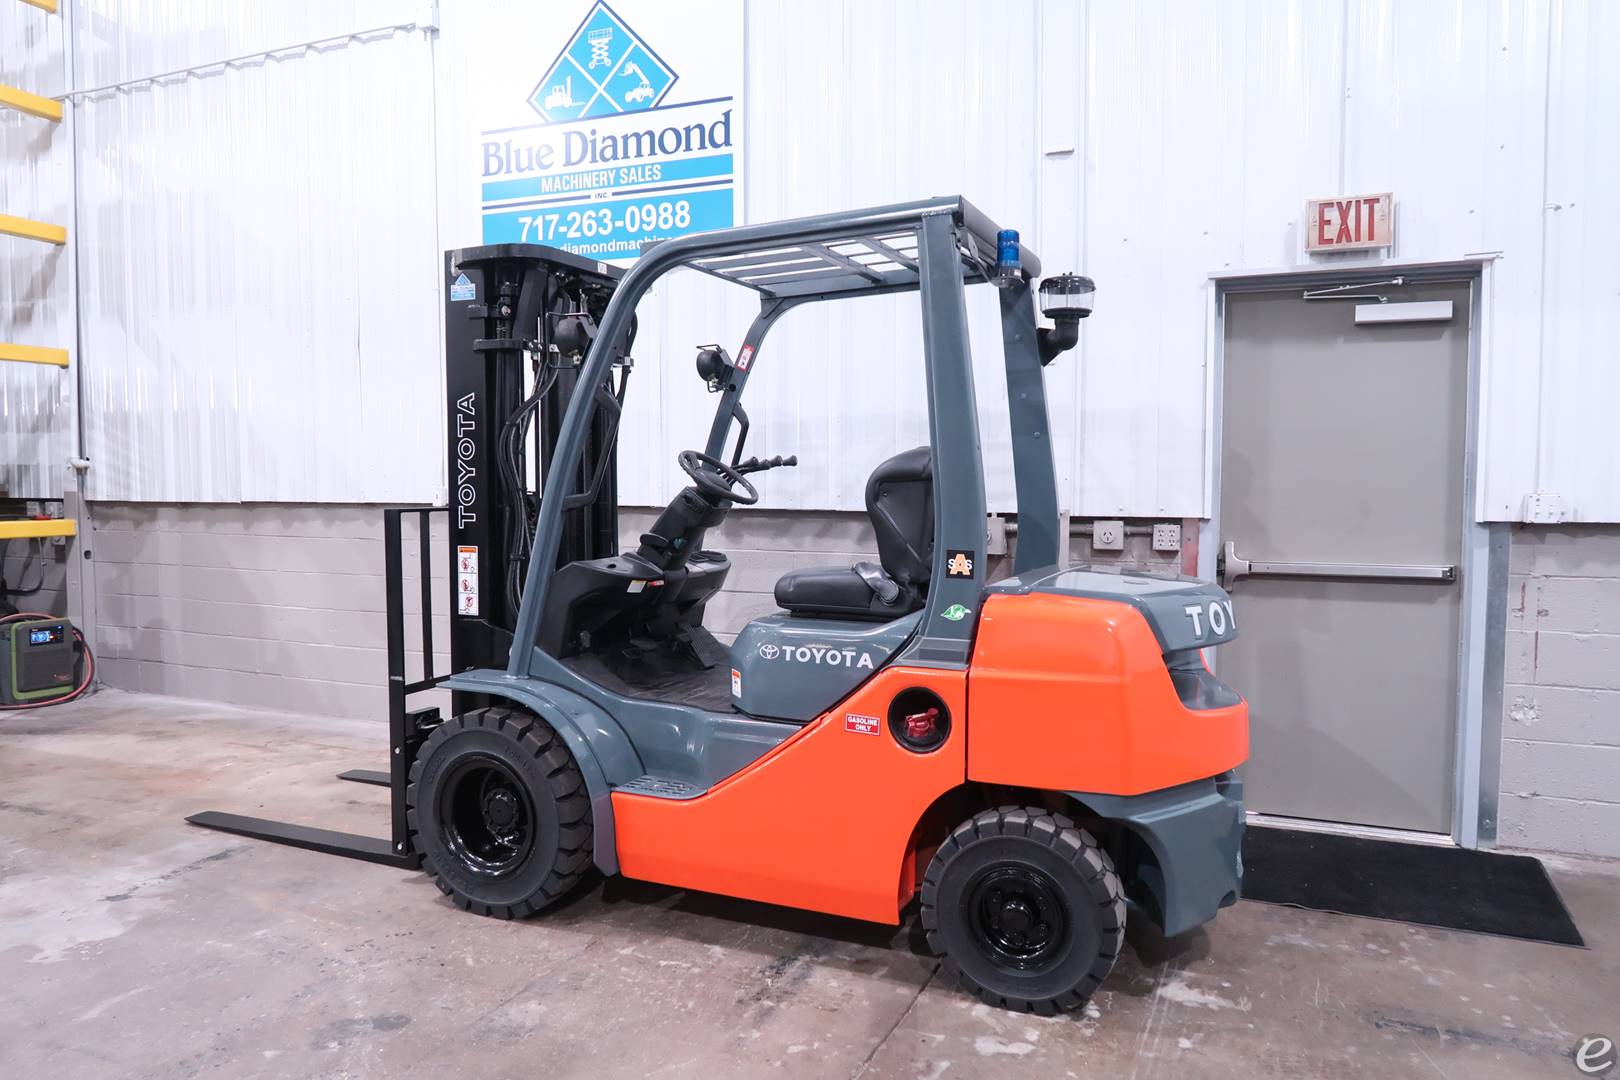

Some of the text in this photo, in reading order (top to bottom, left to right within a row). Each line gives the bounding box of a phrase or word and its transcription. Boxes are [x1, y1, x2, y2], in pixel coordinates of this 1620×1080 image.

[481, 109, 733, 177] Blue Diamond
[541, 164, 662, 193] MACHINERY SALES
[518, 200, 691, 243] 717-263-0988
[1318, 198, 1380, 245] EXIT
[457, 391, 476, 530] TOYOTA
[782, 645, 874, 669] TOYOTA
[847, 716, 878, 727] GASOLINE
[855, 723, 872, 732] ONLY
